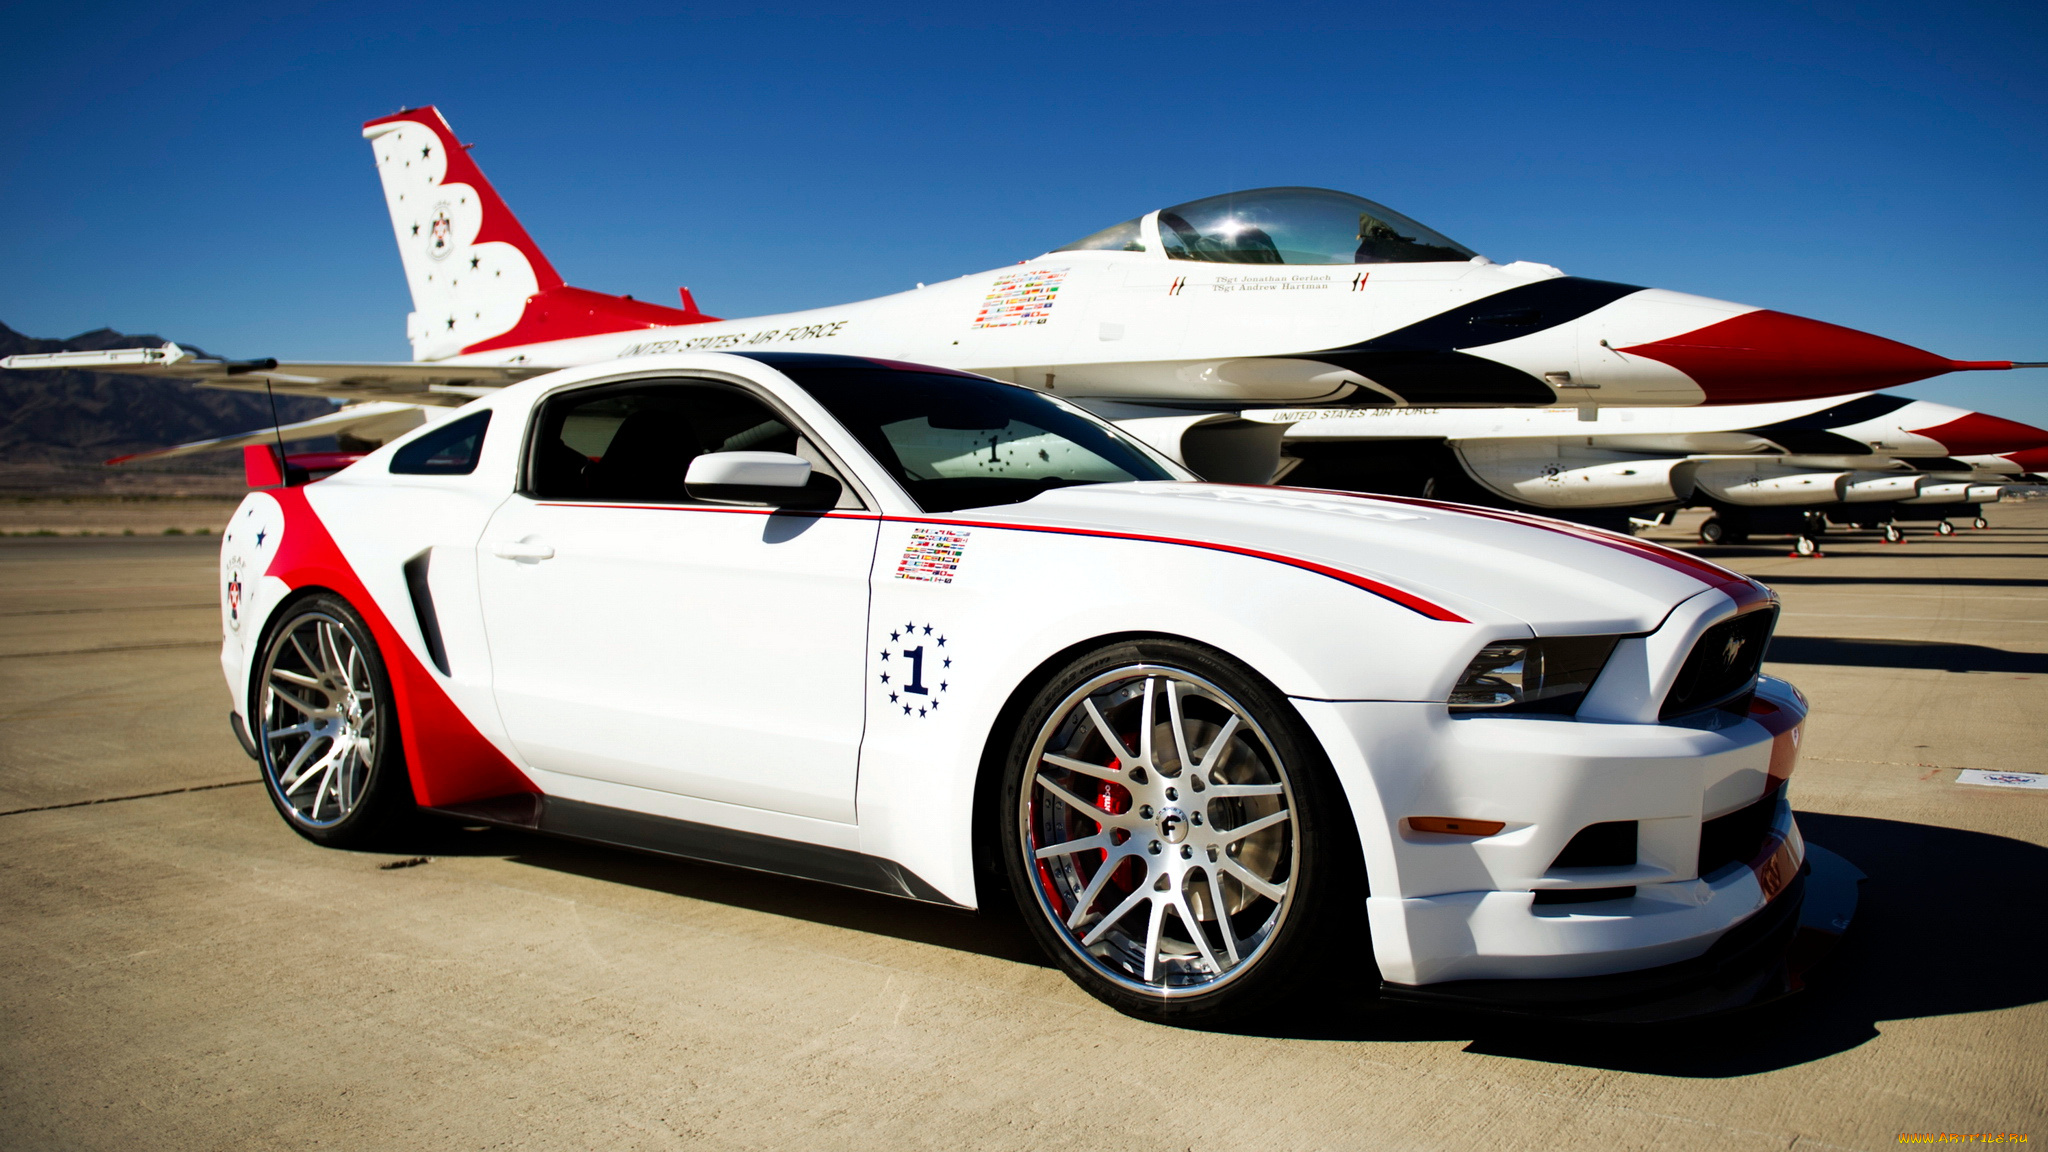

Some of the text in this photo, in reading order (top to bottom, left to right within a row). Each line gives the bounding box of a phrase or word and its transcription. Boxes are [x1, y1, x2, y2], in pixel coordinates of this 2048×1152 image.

[617, 320, 849, 358] UNITED STATES AIR FORCE
[1272, 410, 1317, 422] UNITED
[1320, 408, 1368, 420] STATES
[988, 435, 1001, 463] 1
[1547, 467, 1559, 482] 2
[903, 645, 929, 696] 1
